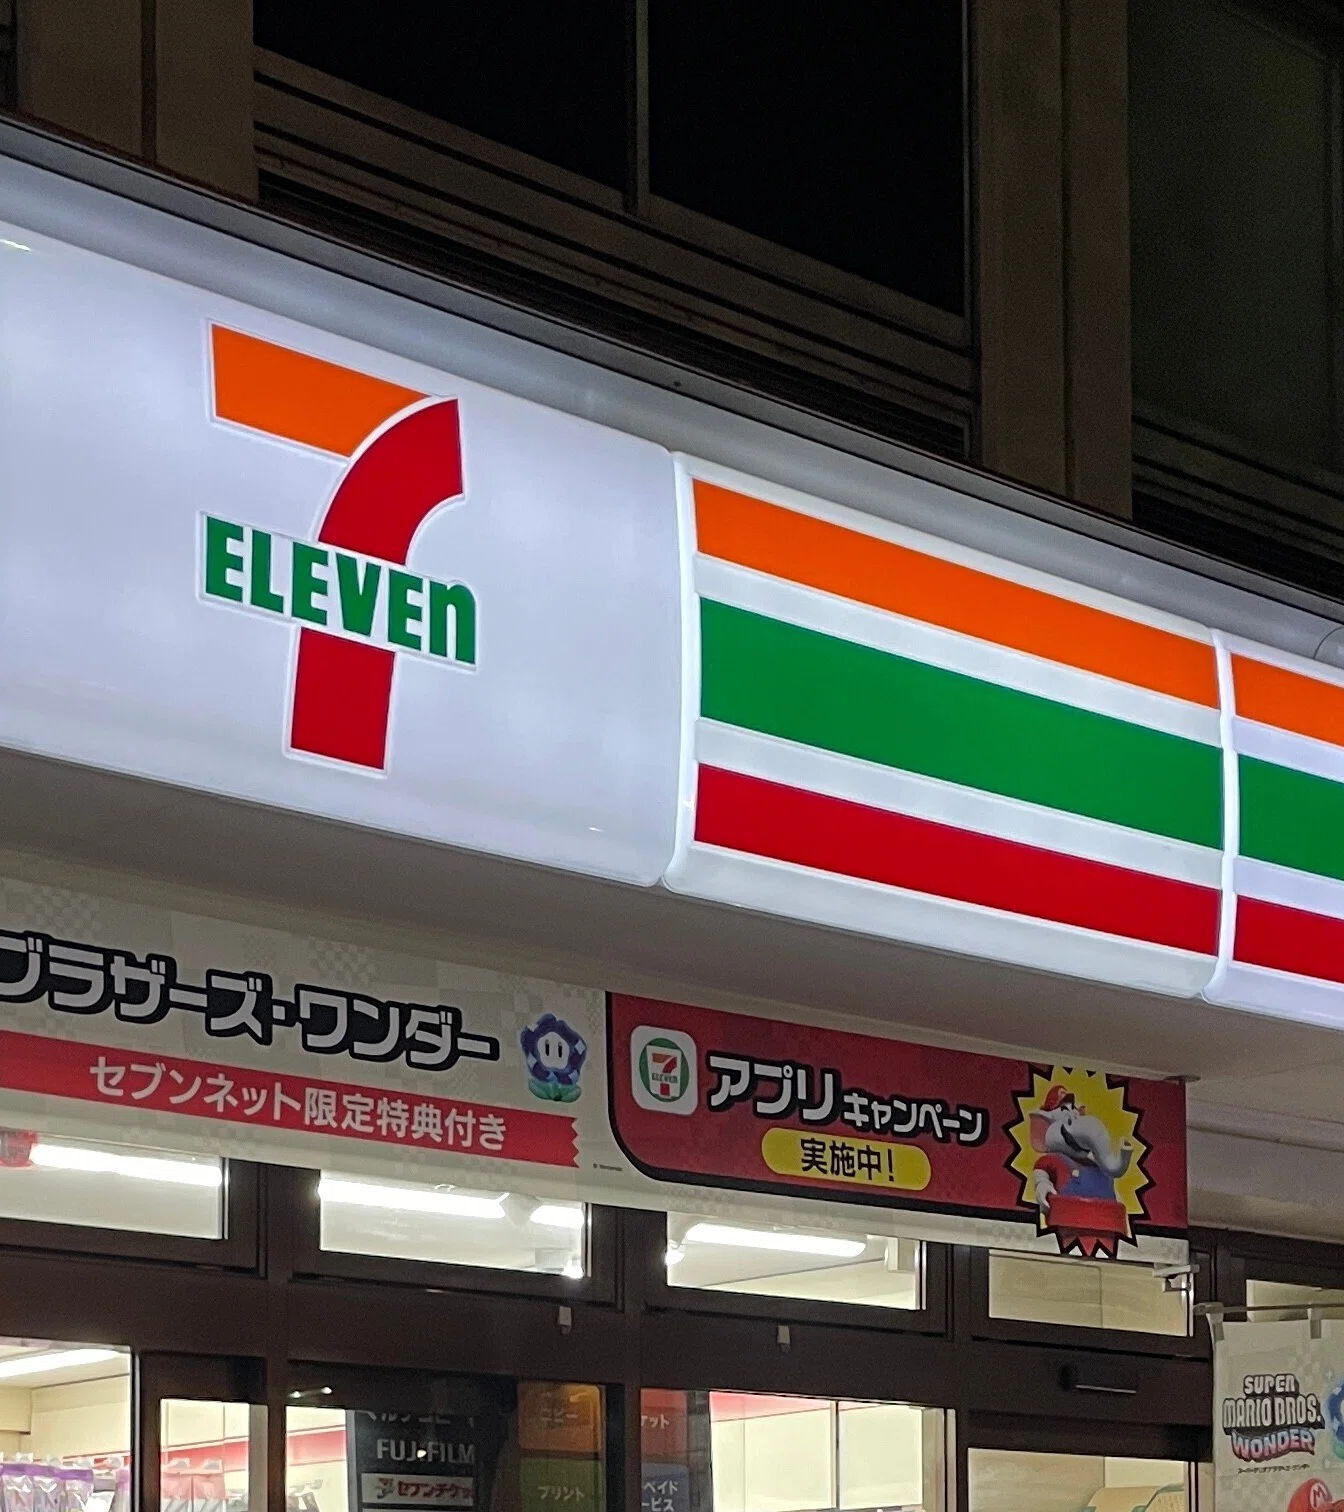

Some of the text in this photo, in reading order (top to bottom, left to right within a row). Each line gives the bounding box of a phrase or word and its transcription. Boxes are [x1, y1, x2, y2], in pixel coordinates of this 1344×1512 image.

[89, 1055, 508, 1152] セブンネット限定特典付き
[799, 1138, 897, 1183] 実施中!
[1243, 1373, 1299, 1396] SUPER
[1222, 1396, 1274, 1429] MARIO
[1231, 1428, 1316, 1463] WONDER
[537, 1485, 585, 1502] プリント
